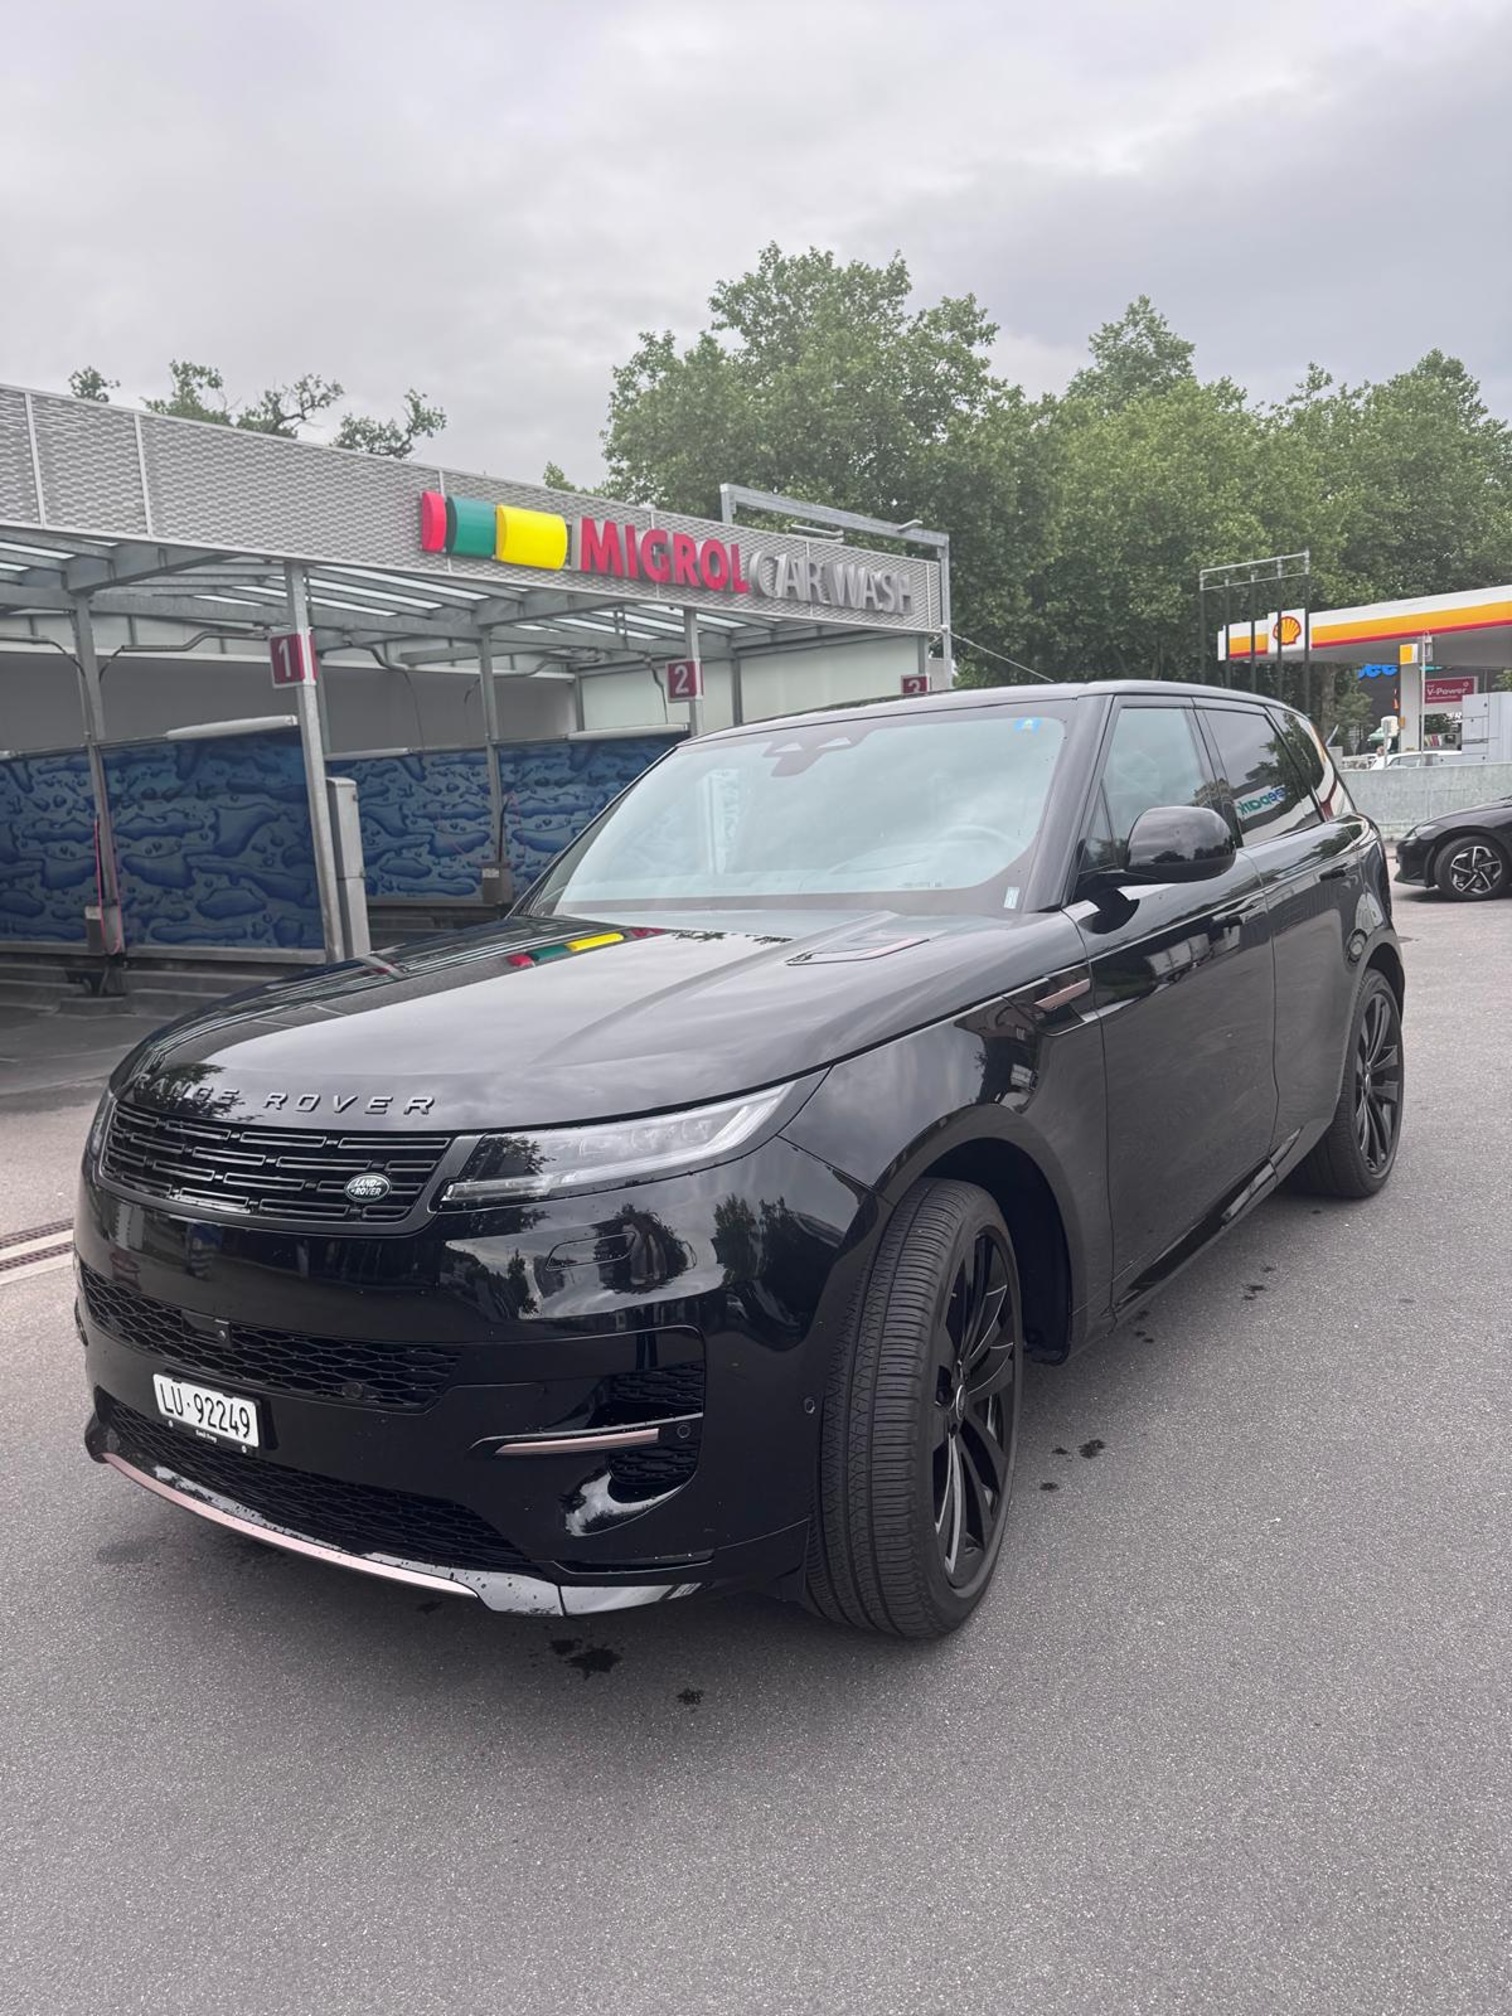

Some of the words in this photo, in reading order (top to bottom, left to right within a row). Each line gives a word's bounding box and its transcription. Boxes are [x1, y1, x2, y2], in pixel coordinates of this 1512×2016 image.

[576, 516, 751, 594] MIGROL
[750, 550, 826, 604] CAR
[824, 562, 915, 616] WASH
[278, 638, 292, 678] 1
[674, 664, 690, 695] 2
[134, 1072, 241, 1107] RANGE
[261, 1091, 436, 1116] ROVER
[353, 1178, 378, 1188] LAND
[353, 1187, 382, 1196] ROVER
